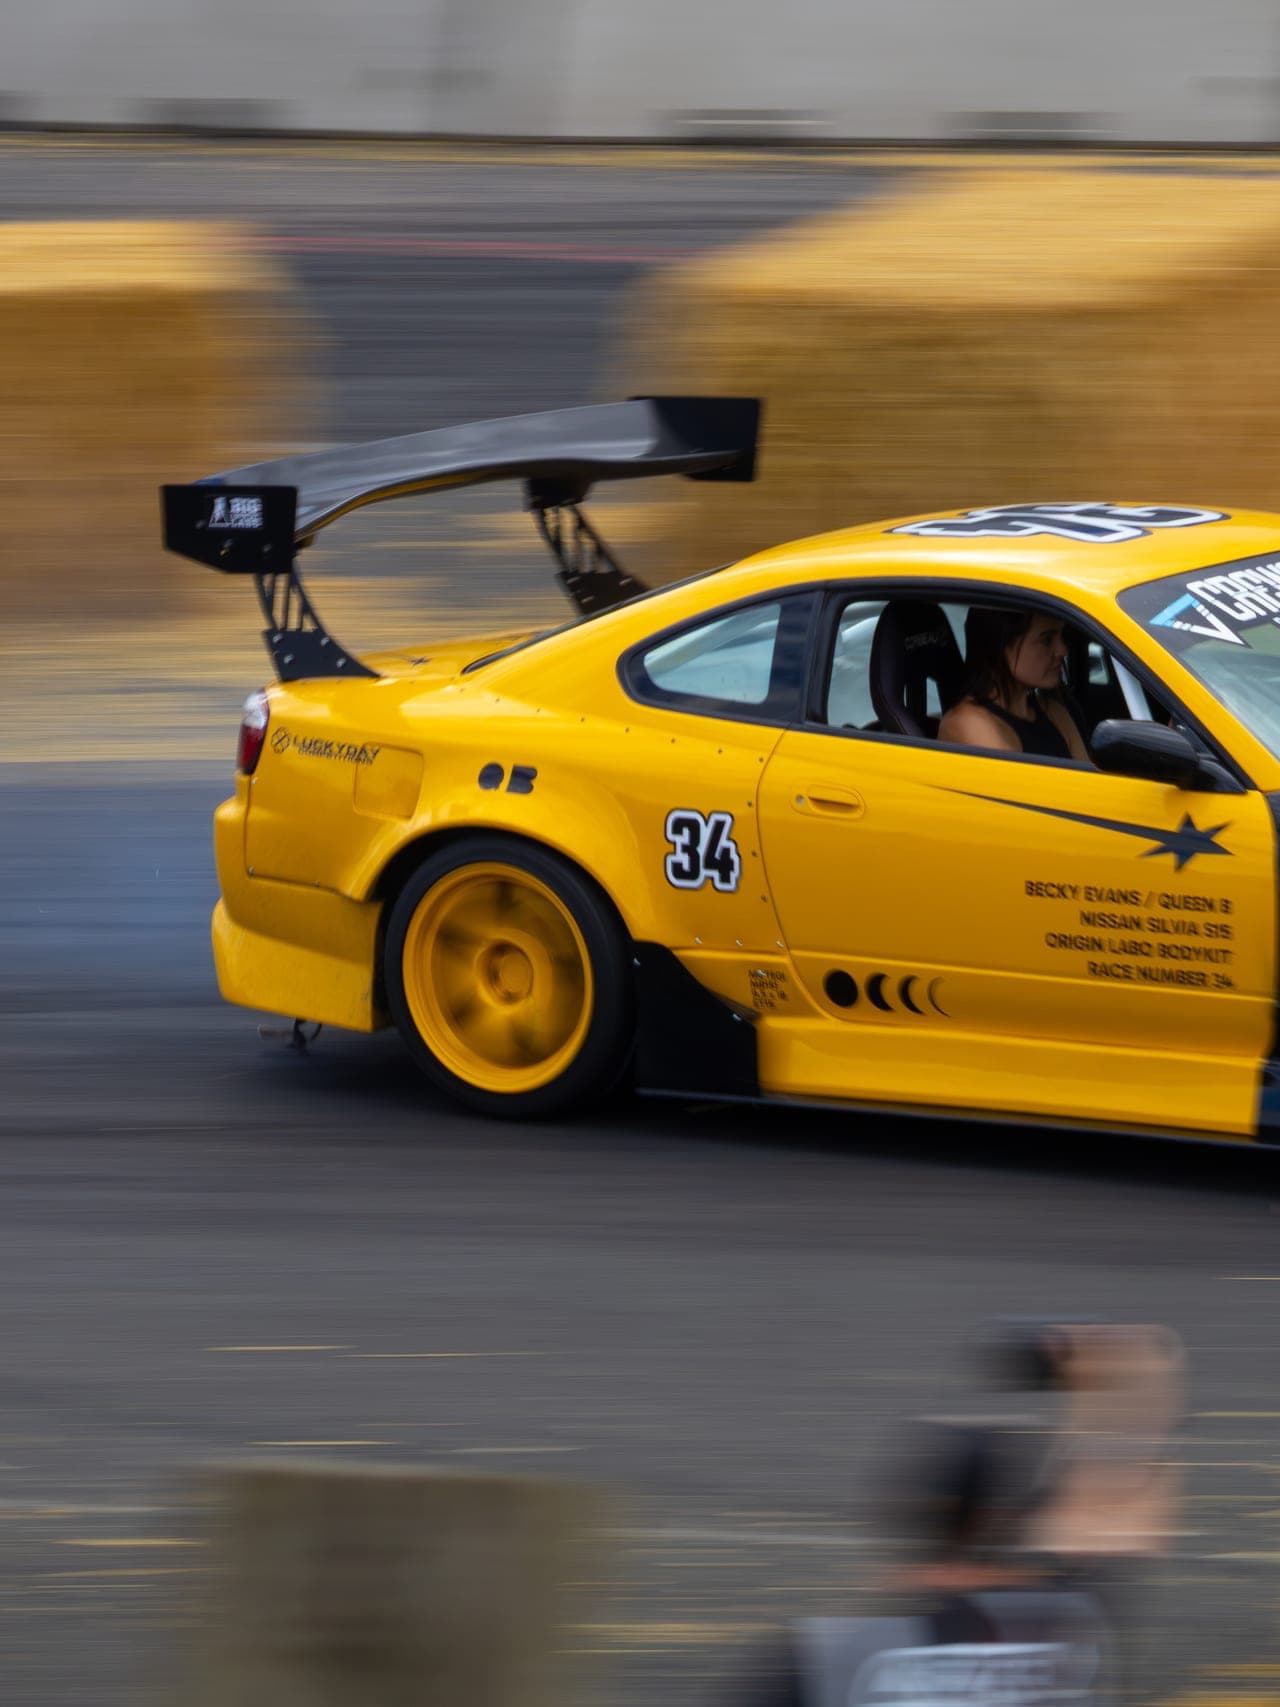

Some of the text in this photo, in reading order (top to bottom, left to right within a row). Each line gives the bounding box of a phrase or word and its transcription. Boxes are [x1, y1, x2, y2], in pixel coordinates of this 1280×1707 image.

[665, 809, 741, 892] 34
[1025, 880, 1079, 900] BECKY
[1083, 885, 1141, 907] EVANS
[1158, 893, 1215, 913] QUEEN
[1079, 911, 1142, 931] NISSAN
[1147, 917, 1199, 936] SILVIA
[1044, 932, 1234, 965] ORIGIN LABO BODYKIT
[1086, 961, 1236, 990] RACE NUMBER 34
